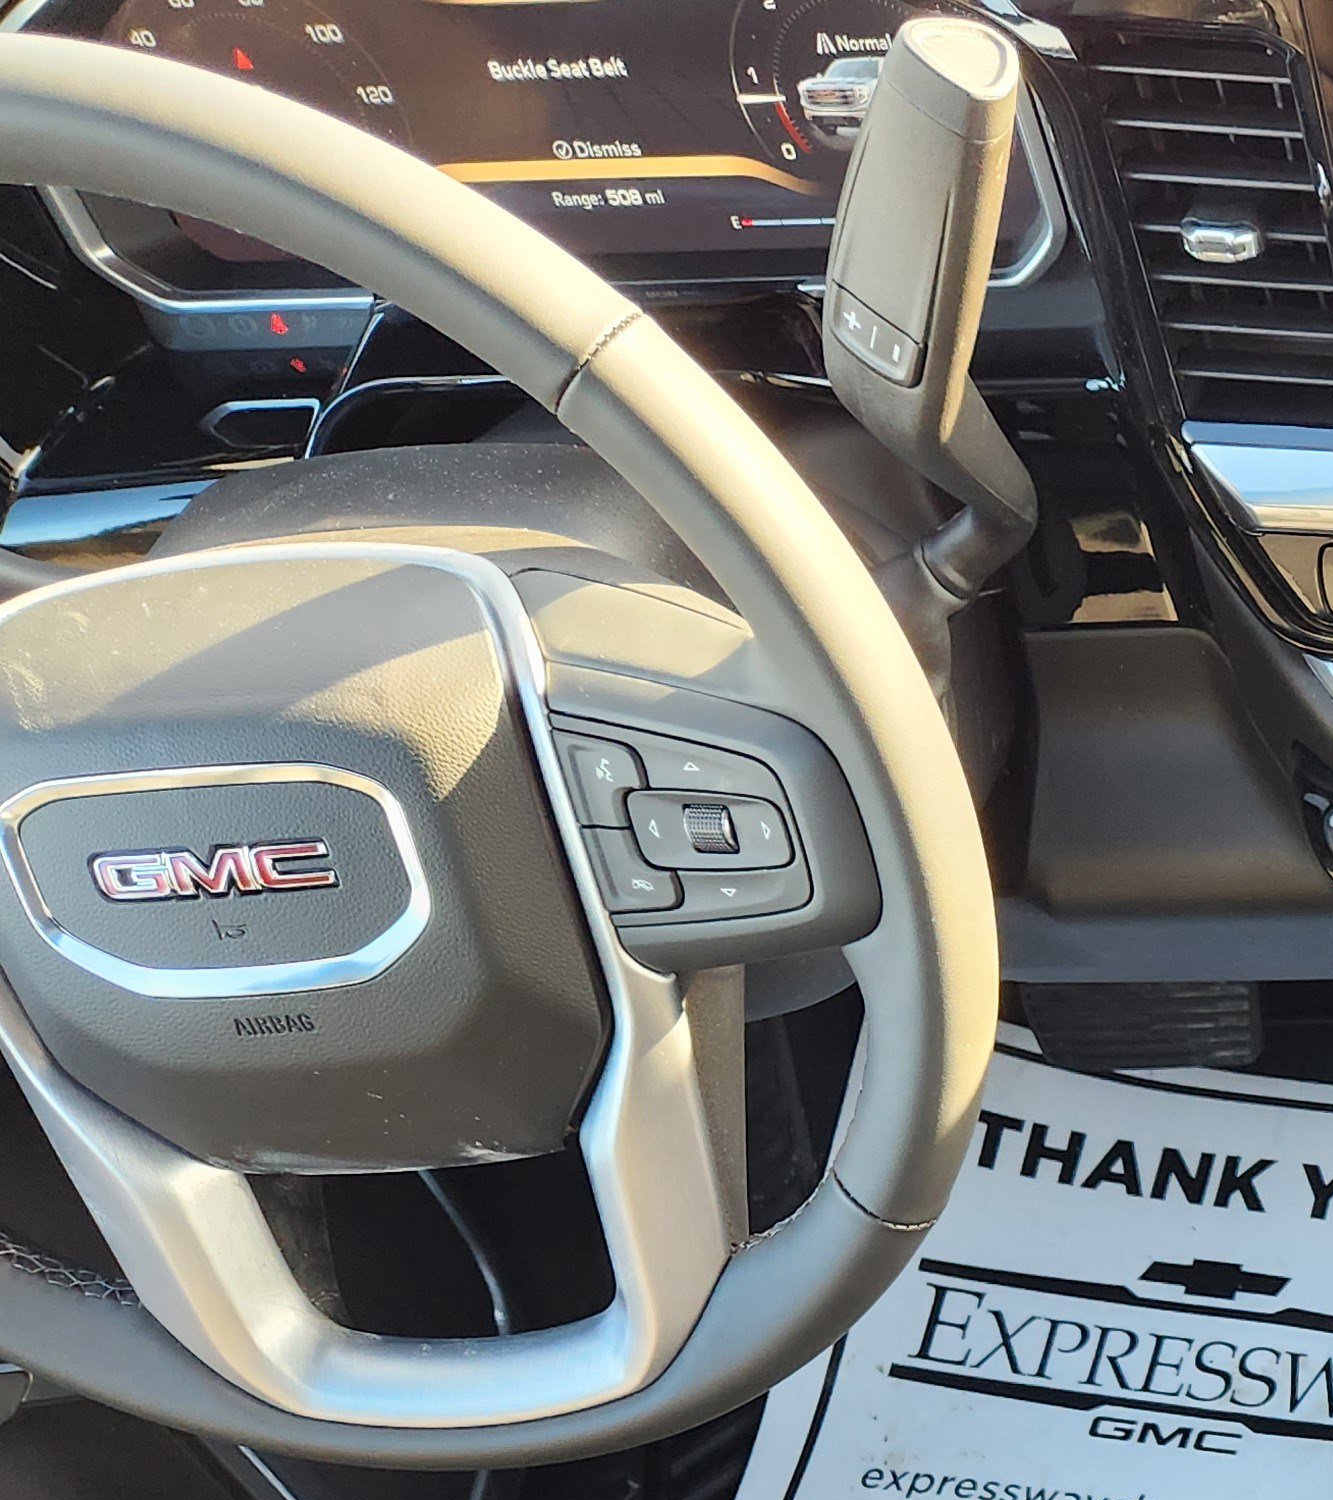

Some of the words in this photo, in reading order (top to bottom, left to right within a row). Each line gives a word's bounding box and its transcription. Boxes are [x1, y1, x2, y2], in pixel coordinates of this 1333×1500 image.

[128, 27, 157, 48] 40
[305, 23, 345, 45] 100
[835, 33, 894, 53] Normal
[487, 57, 549, 82] Buckle
[547, 57, 591, 80] Seat
[588, 56, 629, 79] Belt
[747, 66, 759, 85] 1
[356, 85, 395, 105] 120
[573, 140, 642, 159] Dismiss
[781, 141, 797, 160] 0
[551, 190, 605, 210] Range:
[730, 215, 742, 230] E
[90, 838, 341, 903] GMC
[233, 1013, 316, 1038] AIRBAG
[977, 1109, 1277, 1213] THANK
[1088, 1414, 1245, 1456] GMC
